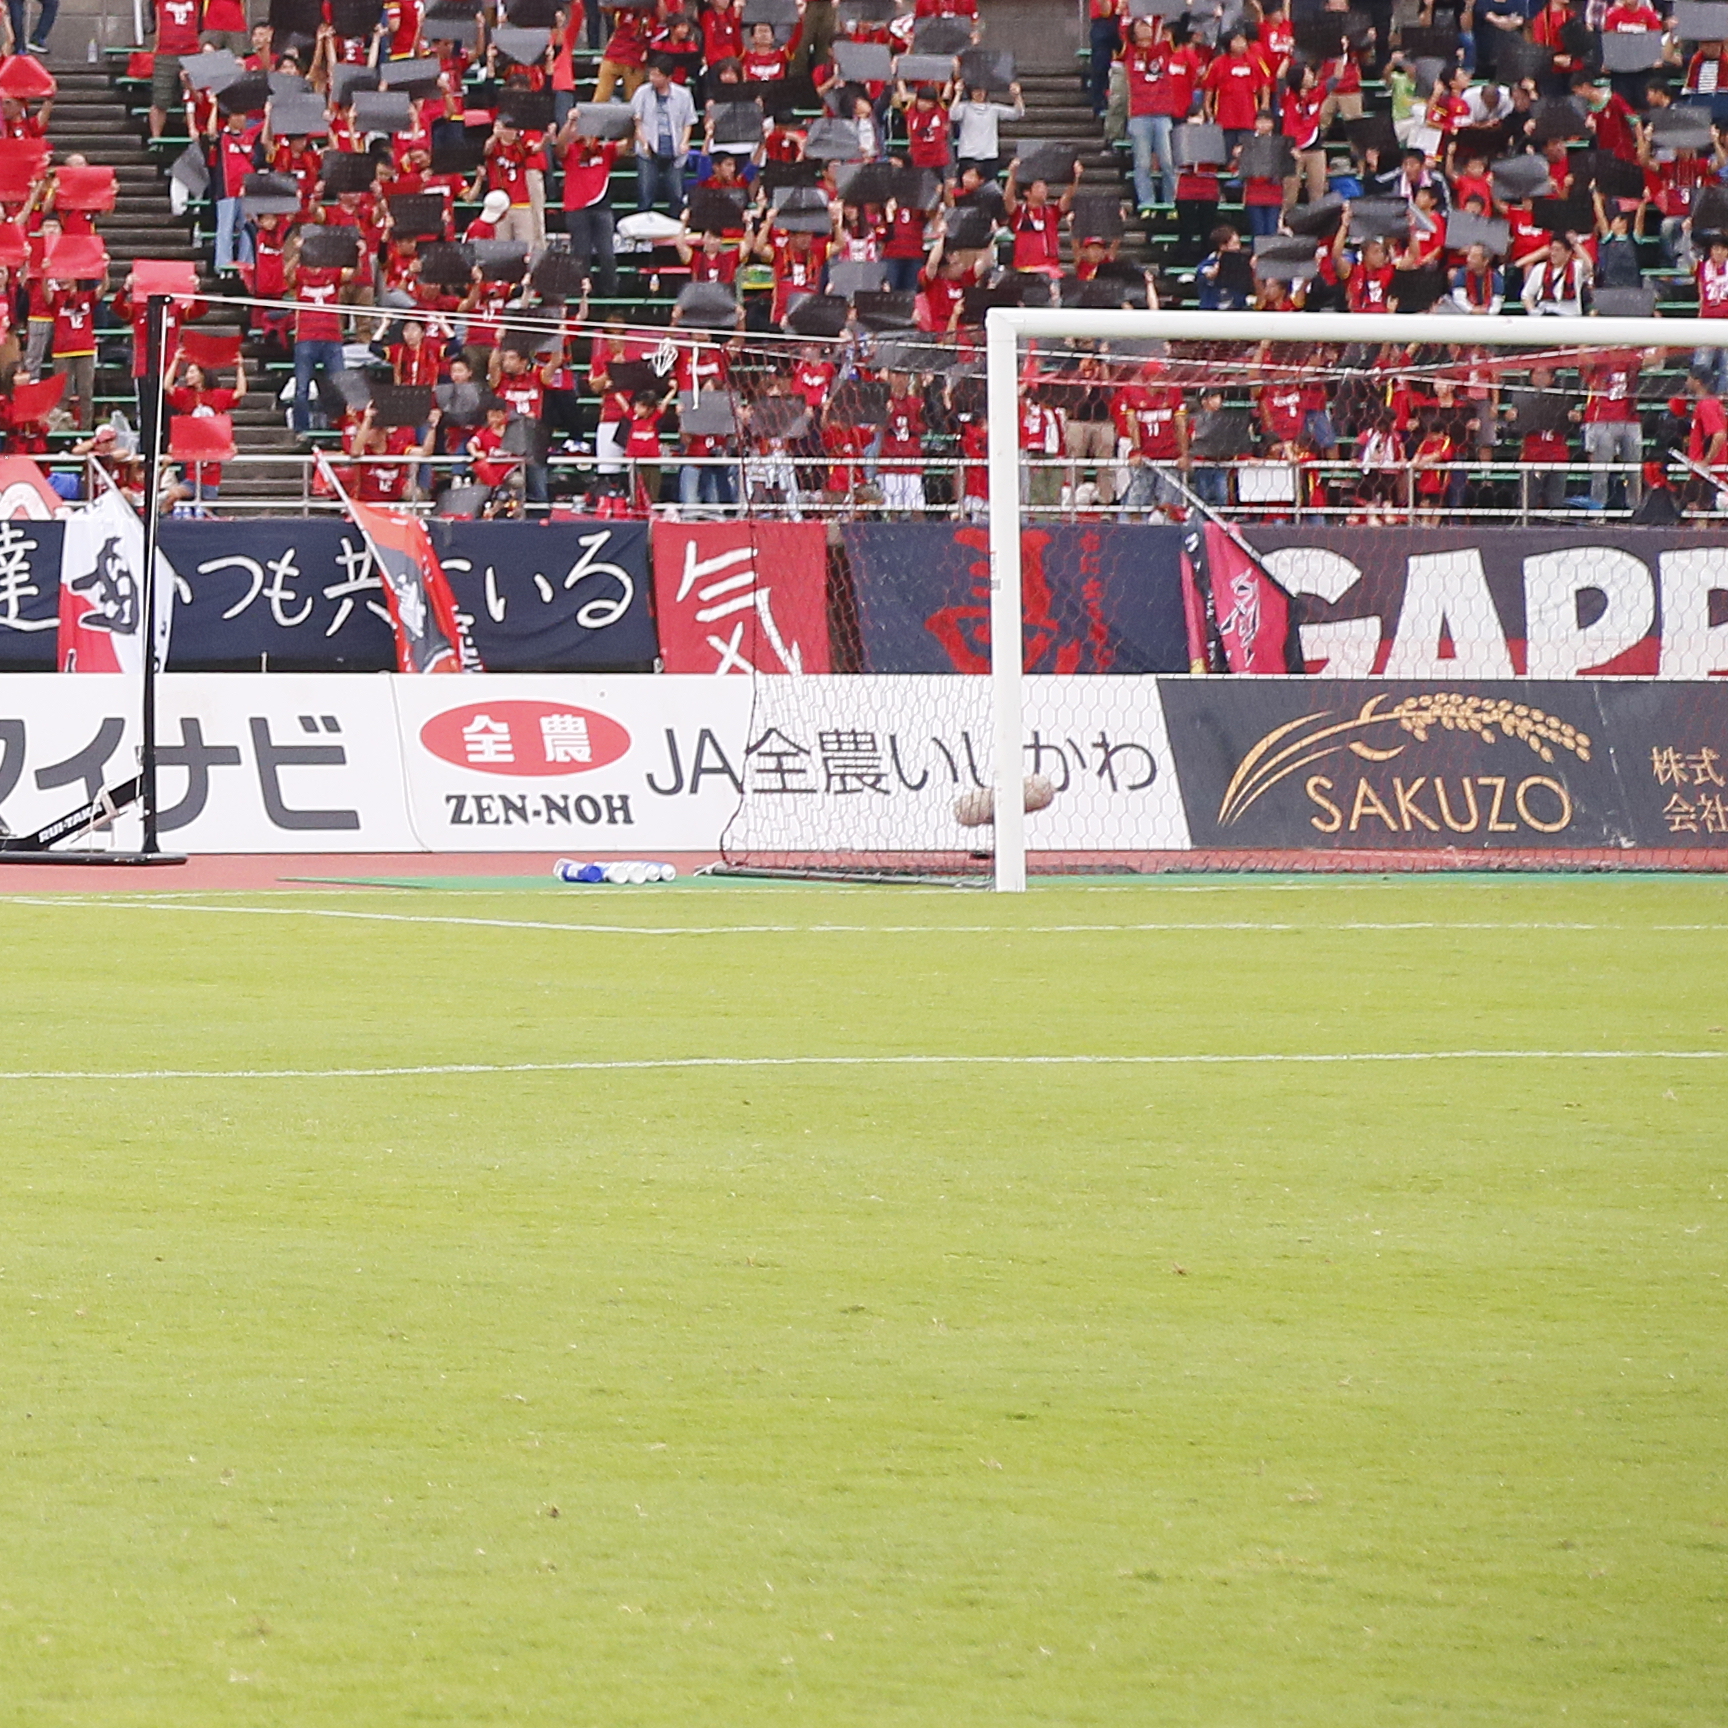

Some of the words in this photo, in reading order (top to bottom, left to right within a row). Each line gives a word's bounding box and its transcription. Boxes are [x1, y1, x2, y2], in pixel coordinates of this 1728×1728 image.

[462, 713, 592, 763] 全農
[1650, 746, 1726, 787] 株式
[446, 794, 634, 825] ZEN-NOH
[1306, 774, 1572, 834] SAKUZO
[1663, 792, 1728, 833] 会社
